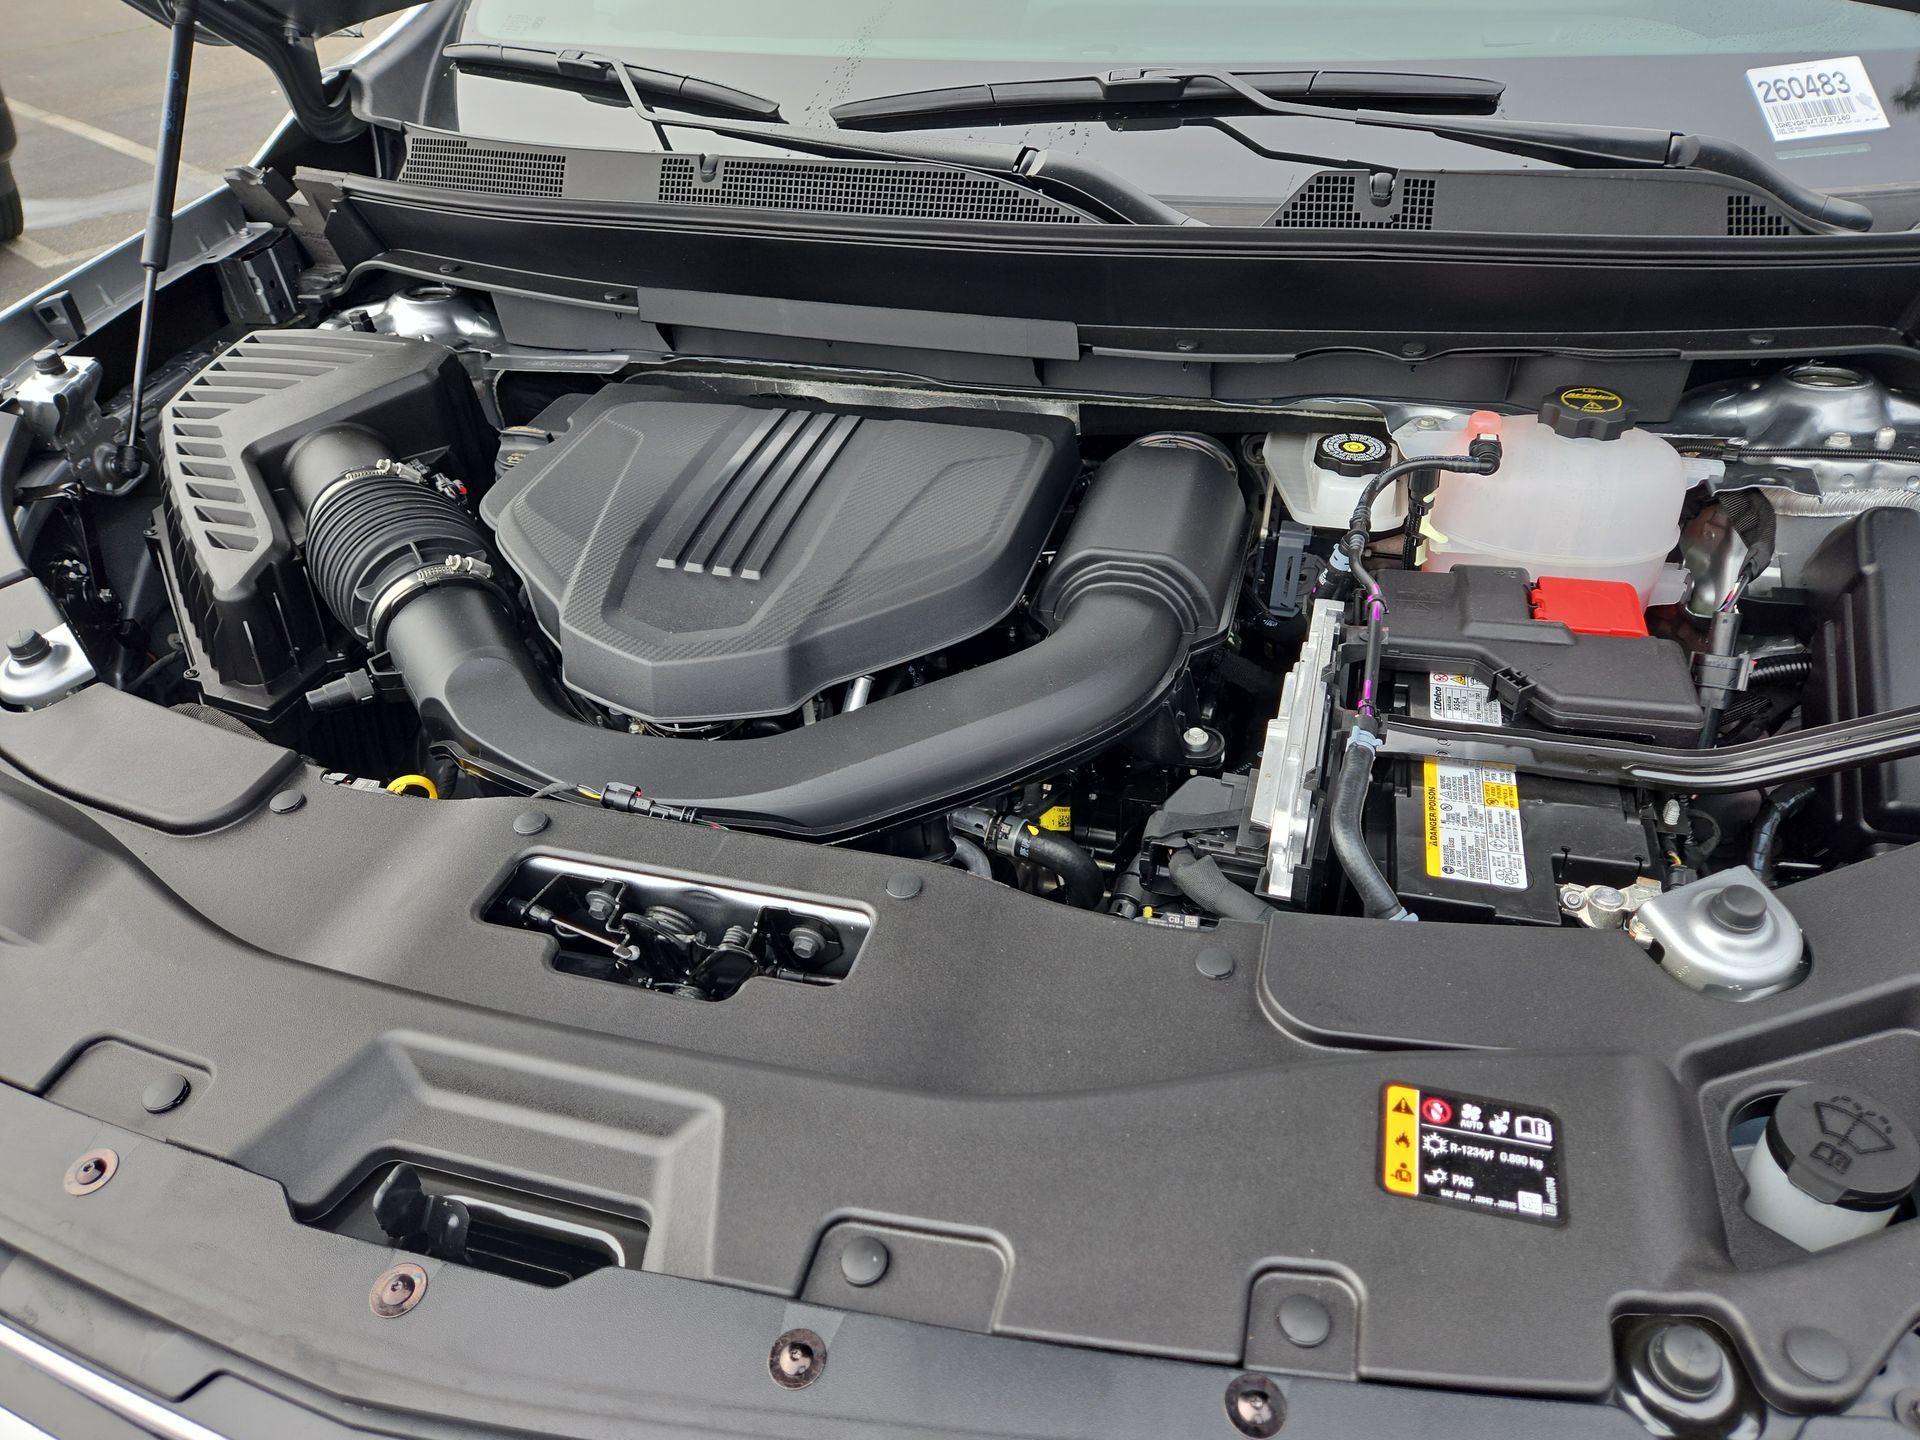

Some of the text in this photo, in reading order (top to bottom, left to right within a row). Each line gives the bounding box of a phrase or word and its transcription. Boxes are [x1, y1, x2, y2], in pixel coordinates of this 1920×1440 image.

[1757, 71, 1851, 103] 260483
[1434, 686, 1442, 716] ACDelco
[1460, 1119, 1483, 1131] AUTO
[1449, 1142, 1494, 1162] R-1234yf
[1529, 1158, 1544, 1172] kg
[1452, 1174, 1475, 1189] PAG
